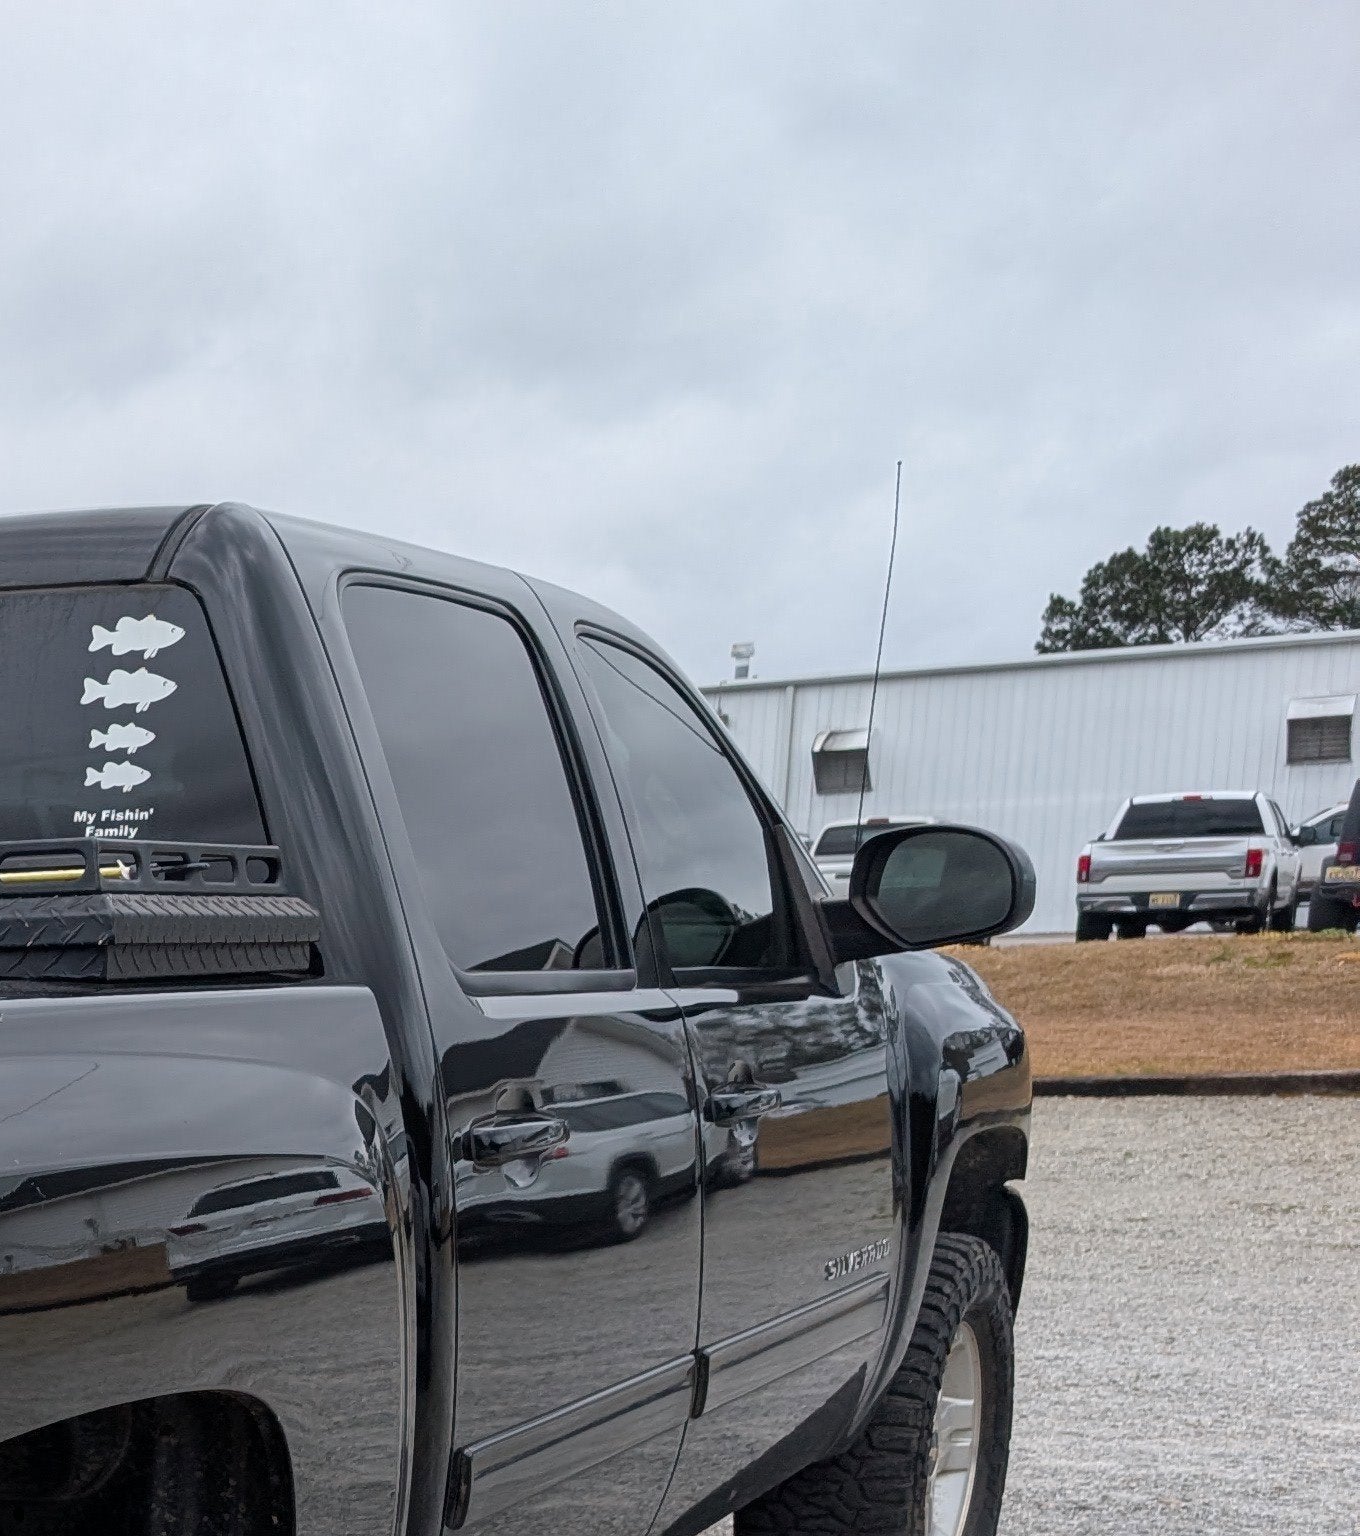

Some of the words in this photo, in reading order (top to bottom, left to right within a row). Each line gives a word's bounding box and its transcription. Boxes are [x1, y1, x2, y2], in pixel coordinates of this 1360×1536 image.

[73, 810, 97, 825] My
[101, 807, 154, 822] Fishin'
[85, 824, 139, 839] Family
[824, 1238, 891, 1281] SILVERADO
